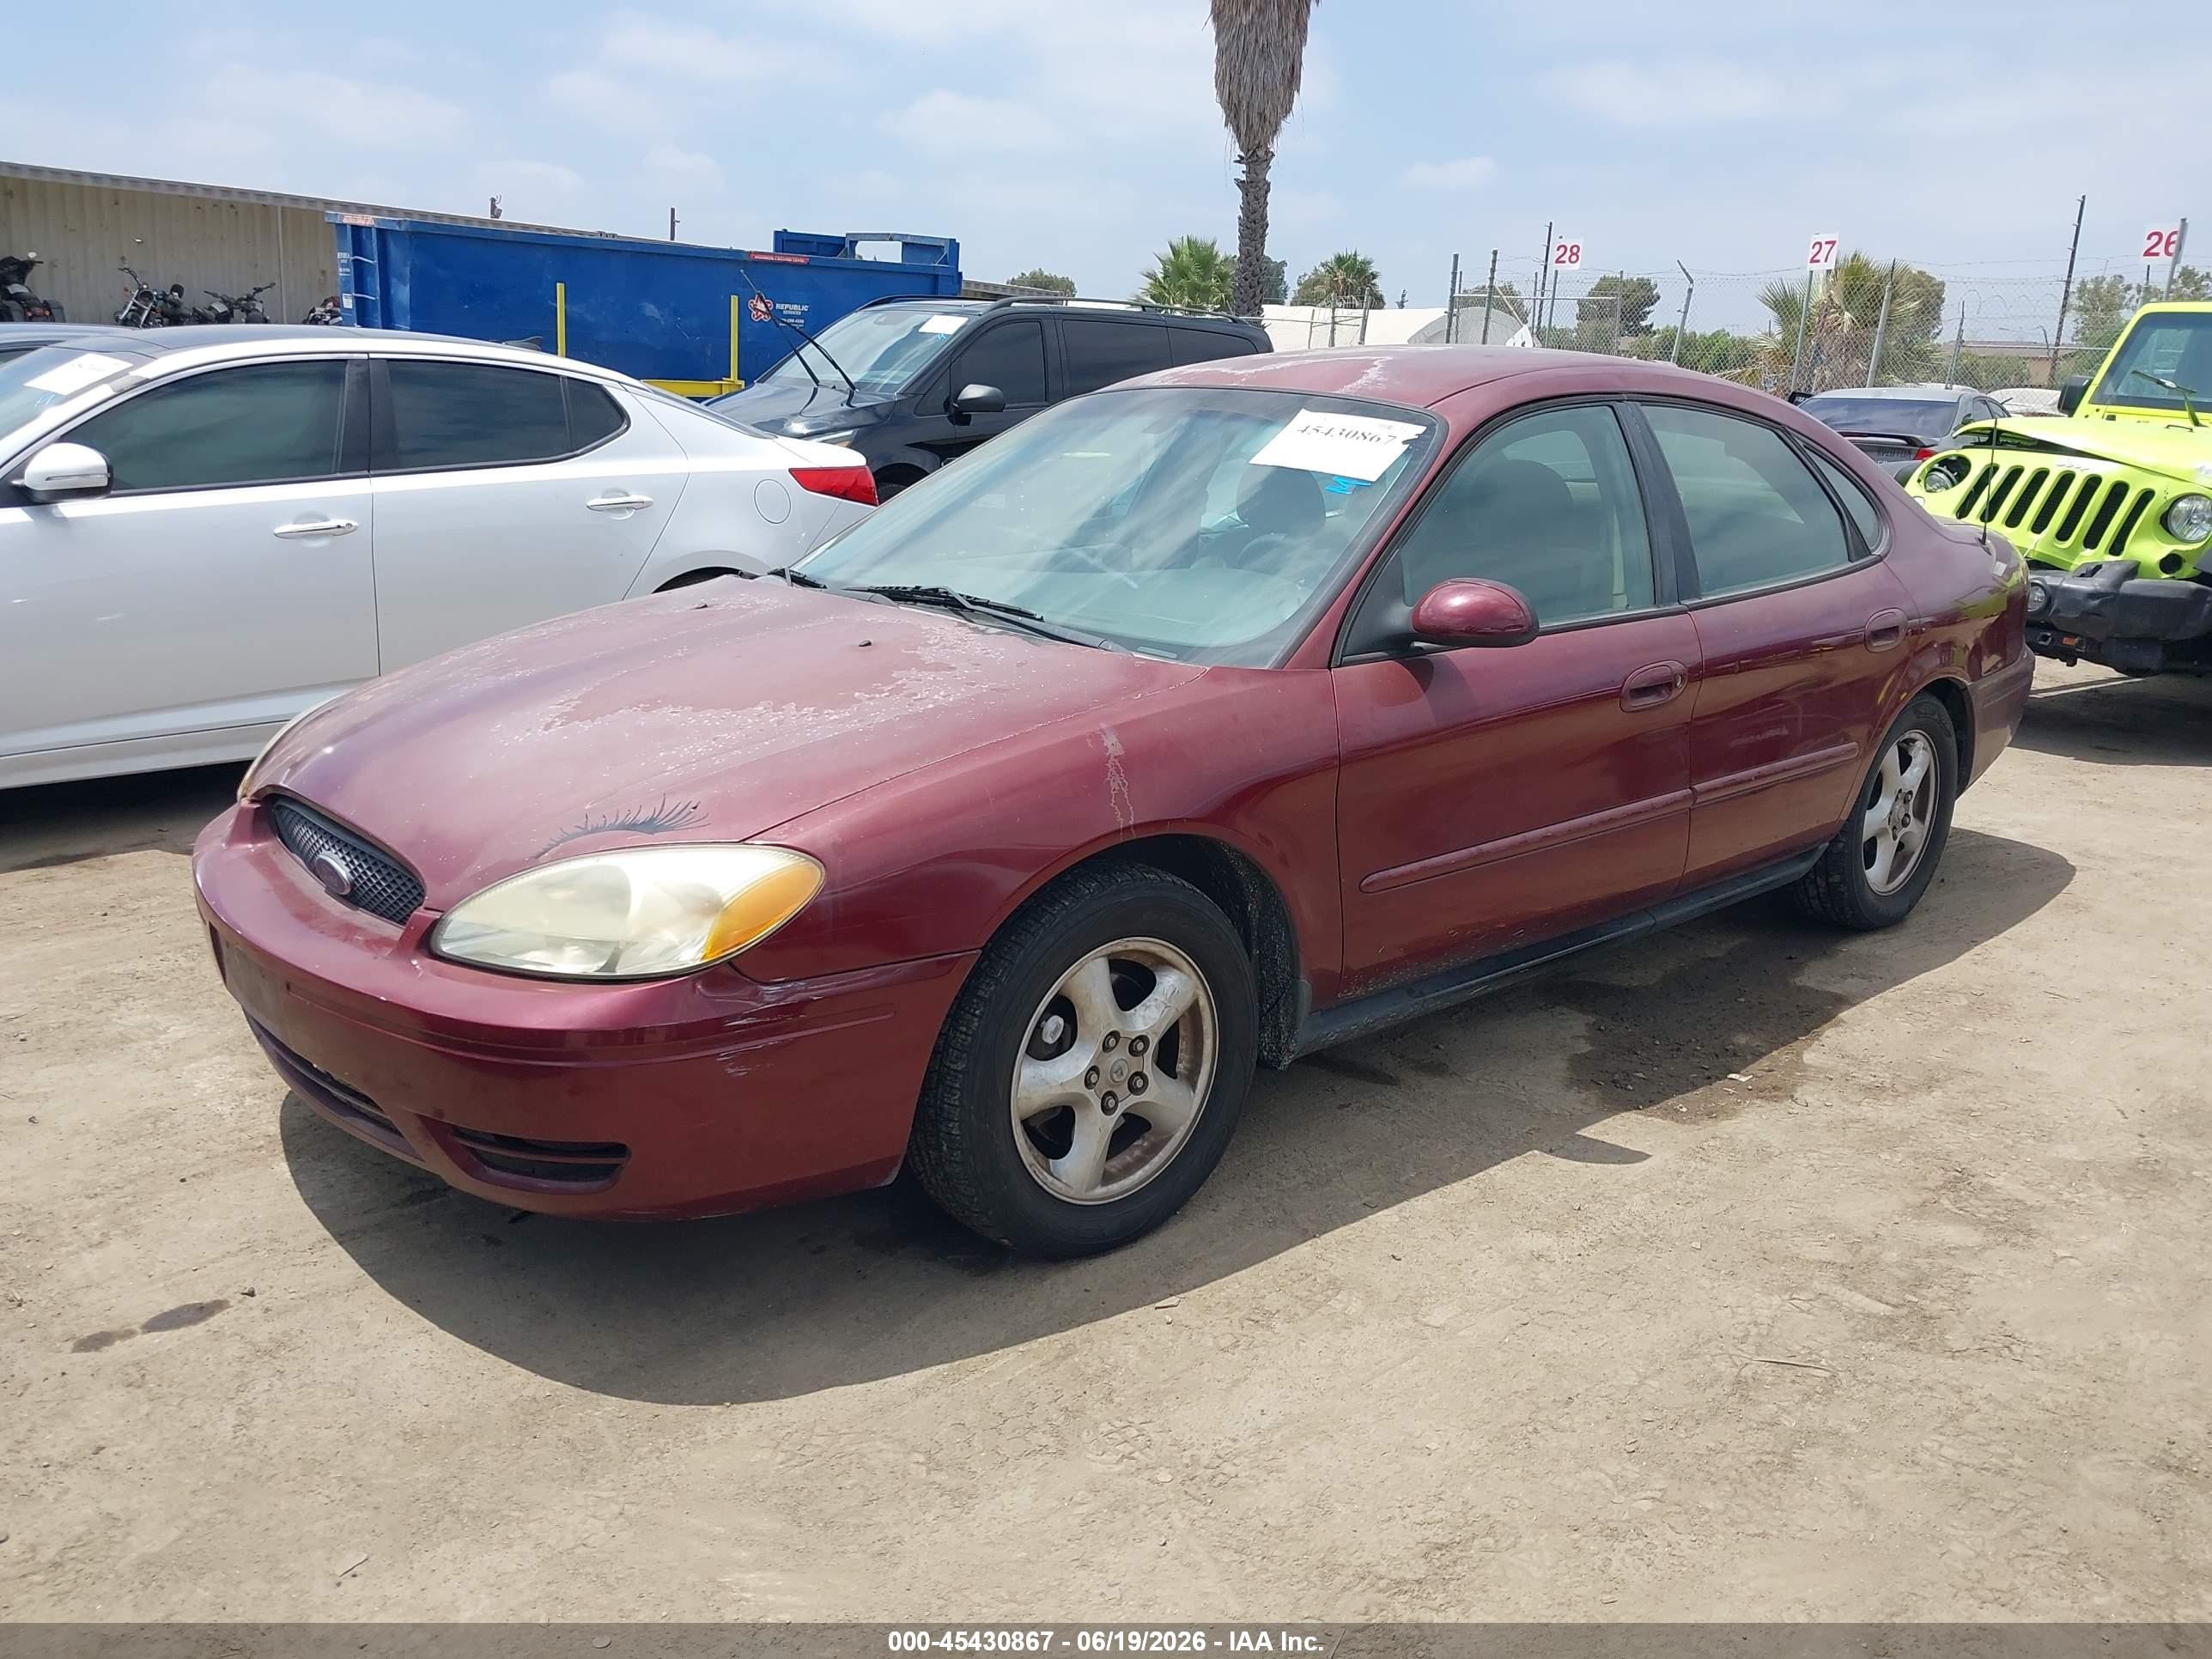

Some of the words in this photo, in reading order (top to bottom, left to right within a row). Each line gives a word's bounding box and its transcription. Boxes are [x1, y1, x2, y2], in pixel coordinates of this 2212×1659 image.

[1554, 244, 1581, 264] 28
[1809, 240, 1837, 264] 27
[2143, 230, 2179, 257] 26
[775, 303, 810, 312] REPUBLIC
[1297, 424, 1398, 446] 45430867
